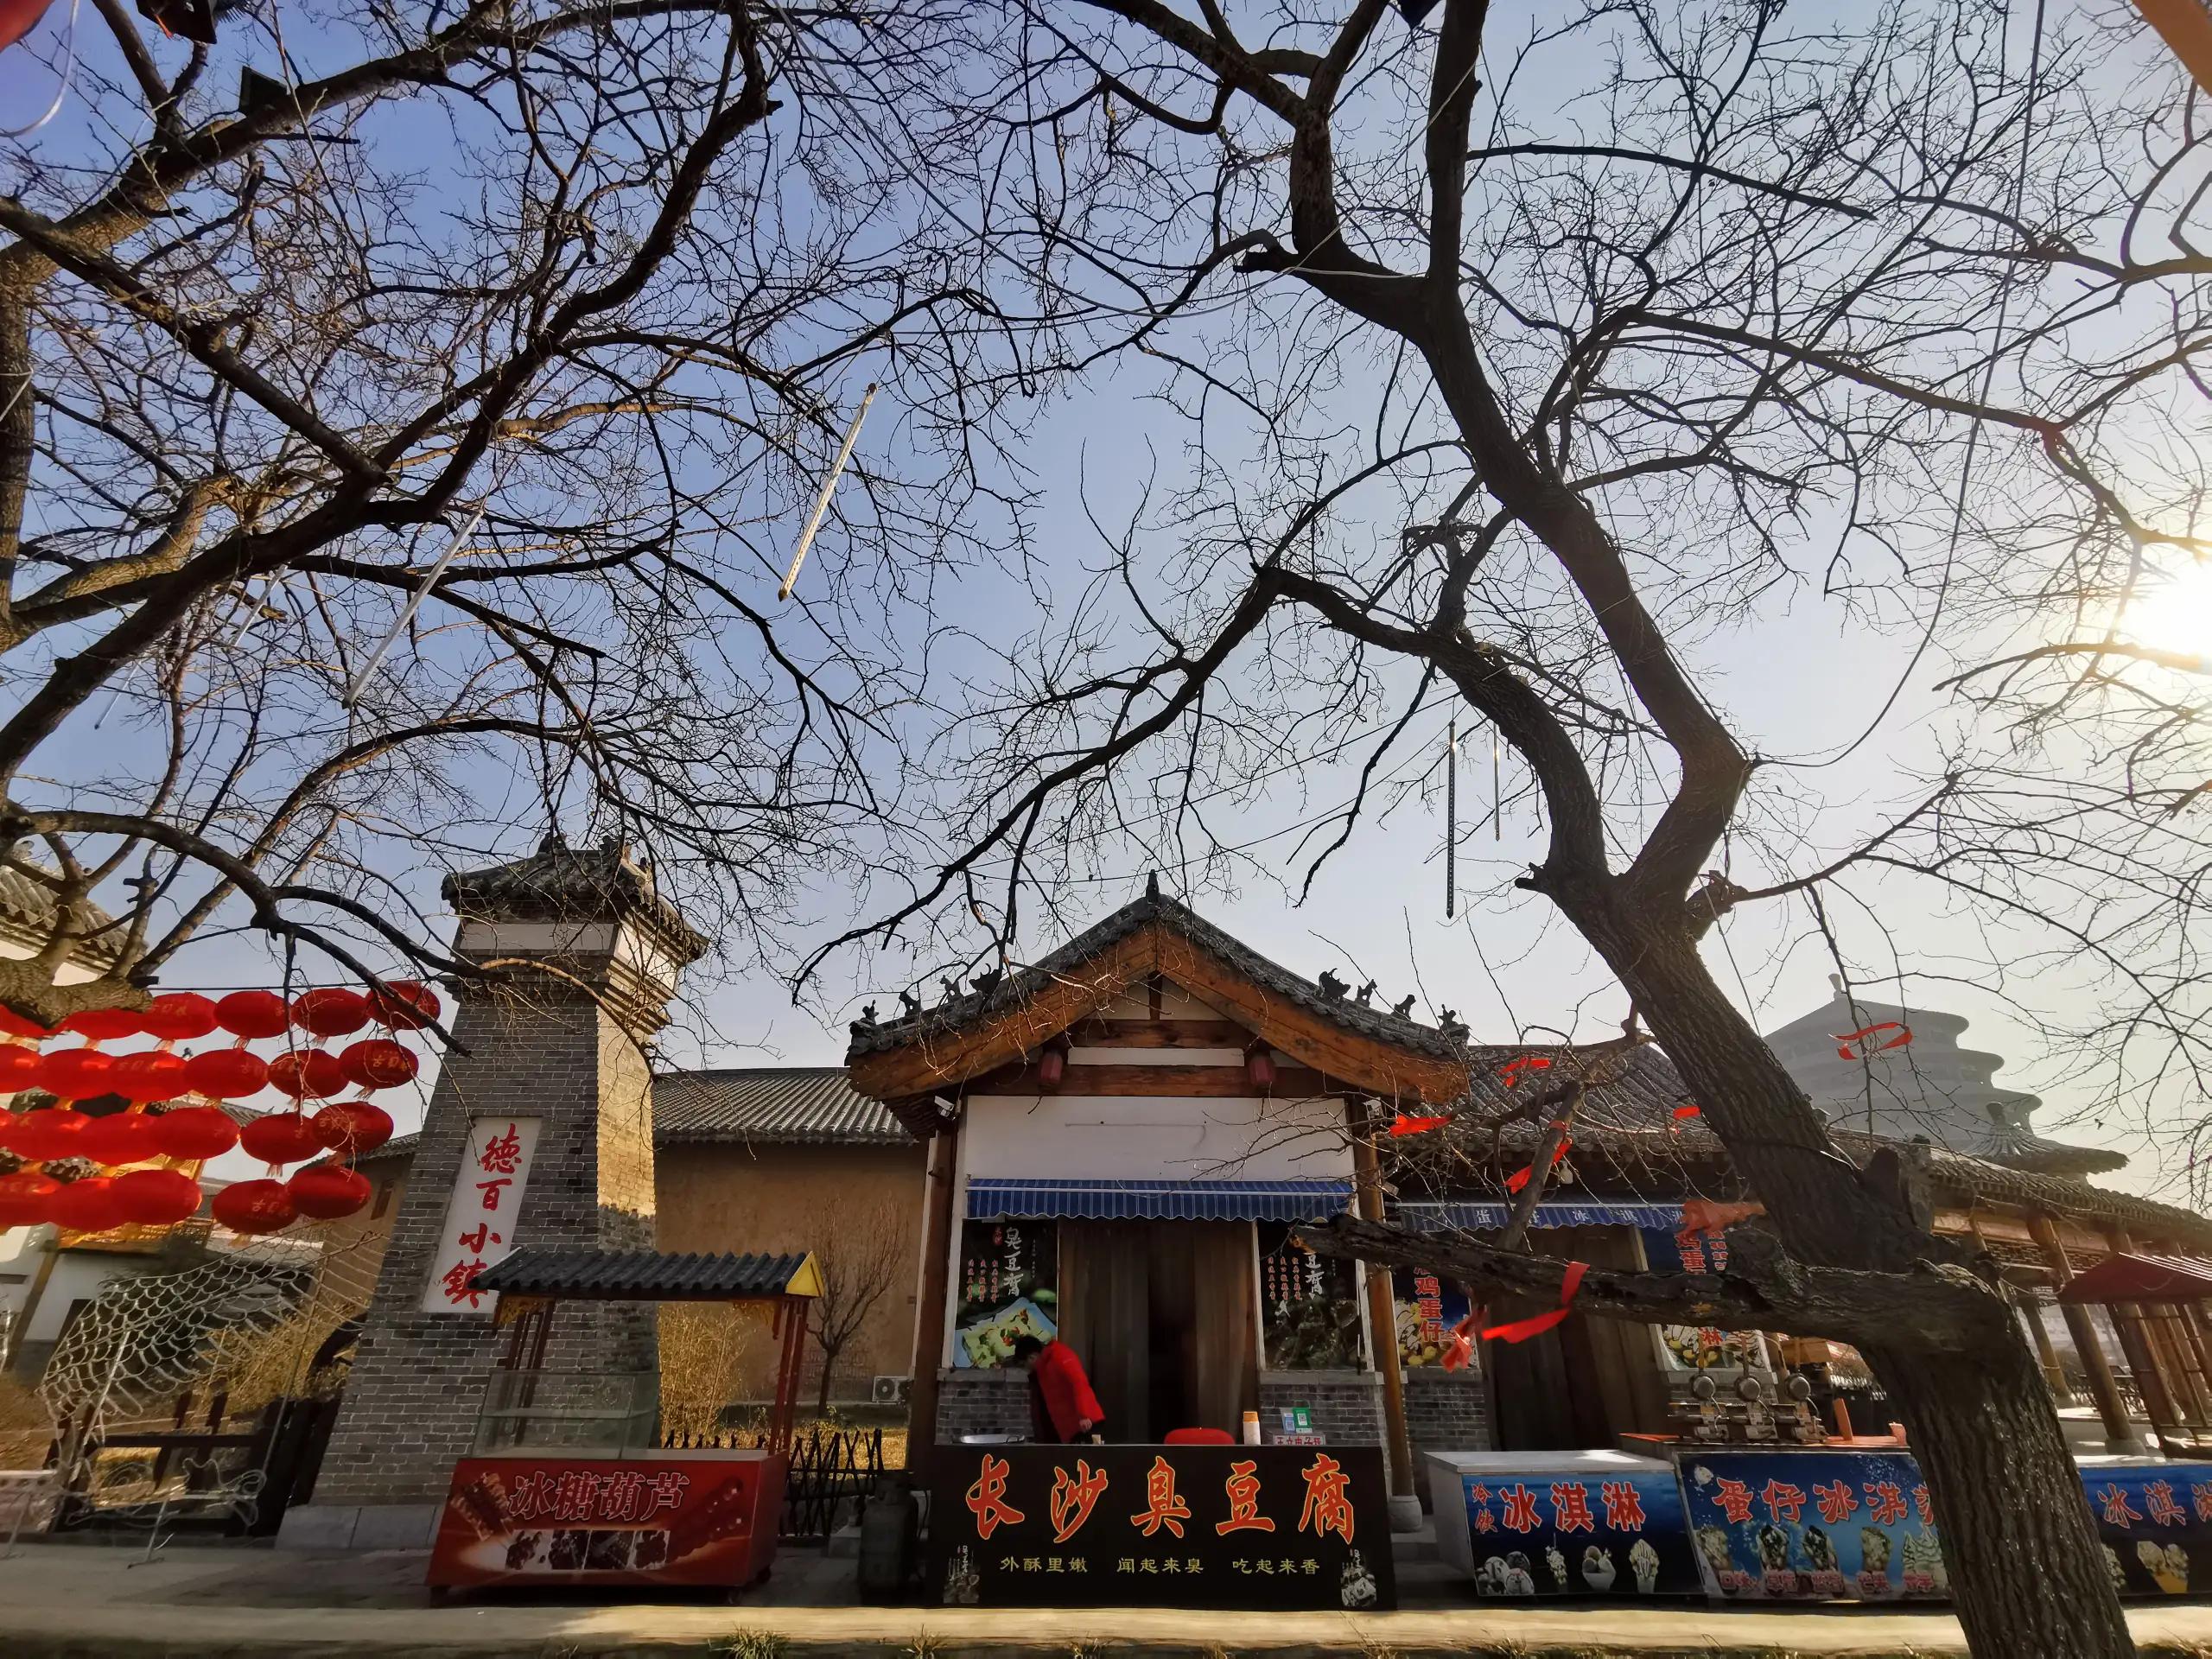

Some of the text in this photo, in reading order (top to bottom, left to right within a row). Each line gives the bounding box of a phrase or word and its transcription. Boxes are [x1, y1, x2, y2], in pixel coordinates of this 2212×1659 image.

[1675, 1230, 1707, 1274] 鸡蛋
[508, 1471, 690, 1521] 冰糖葫芦
[966, 1453, 1354, 1545] 长沙臭豆腐
[1471, 1481, 1498, 1535] 冷饮
[1498, 1481, 1646, 1535] 冰淇淋
[1000, 1556, 1089, 1574] 外酥里嫩
[1116, 1557, 1205, 1575] 闻起来臭
[1232, 1558, 1320, 1576] 吃起来香
